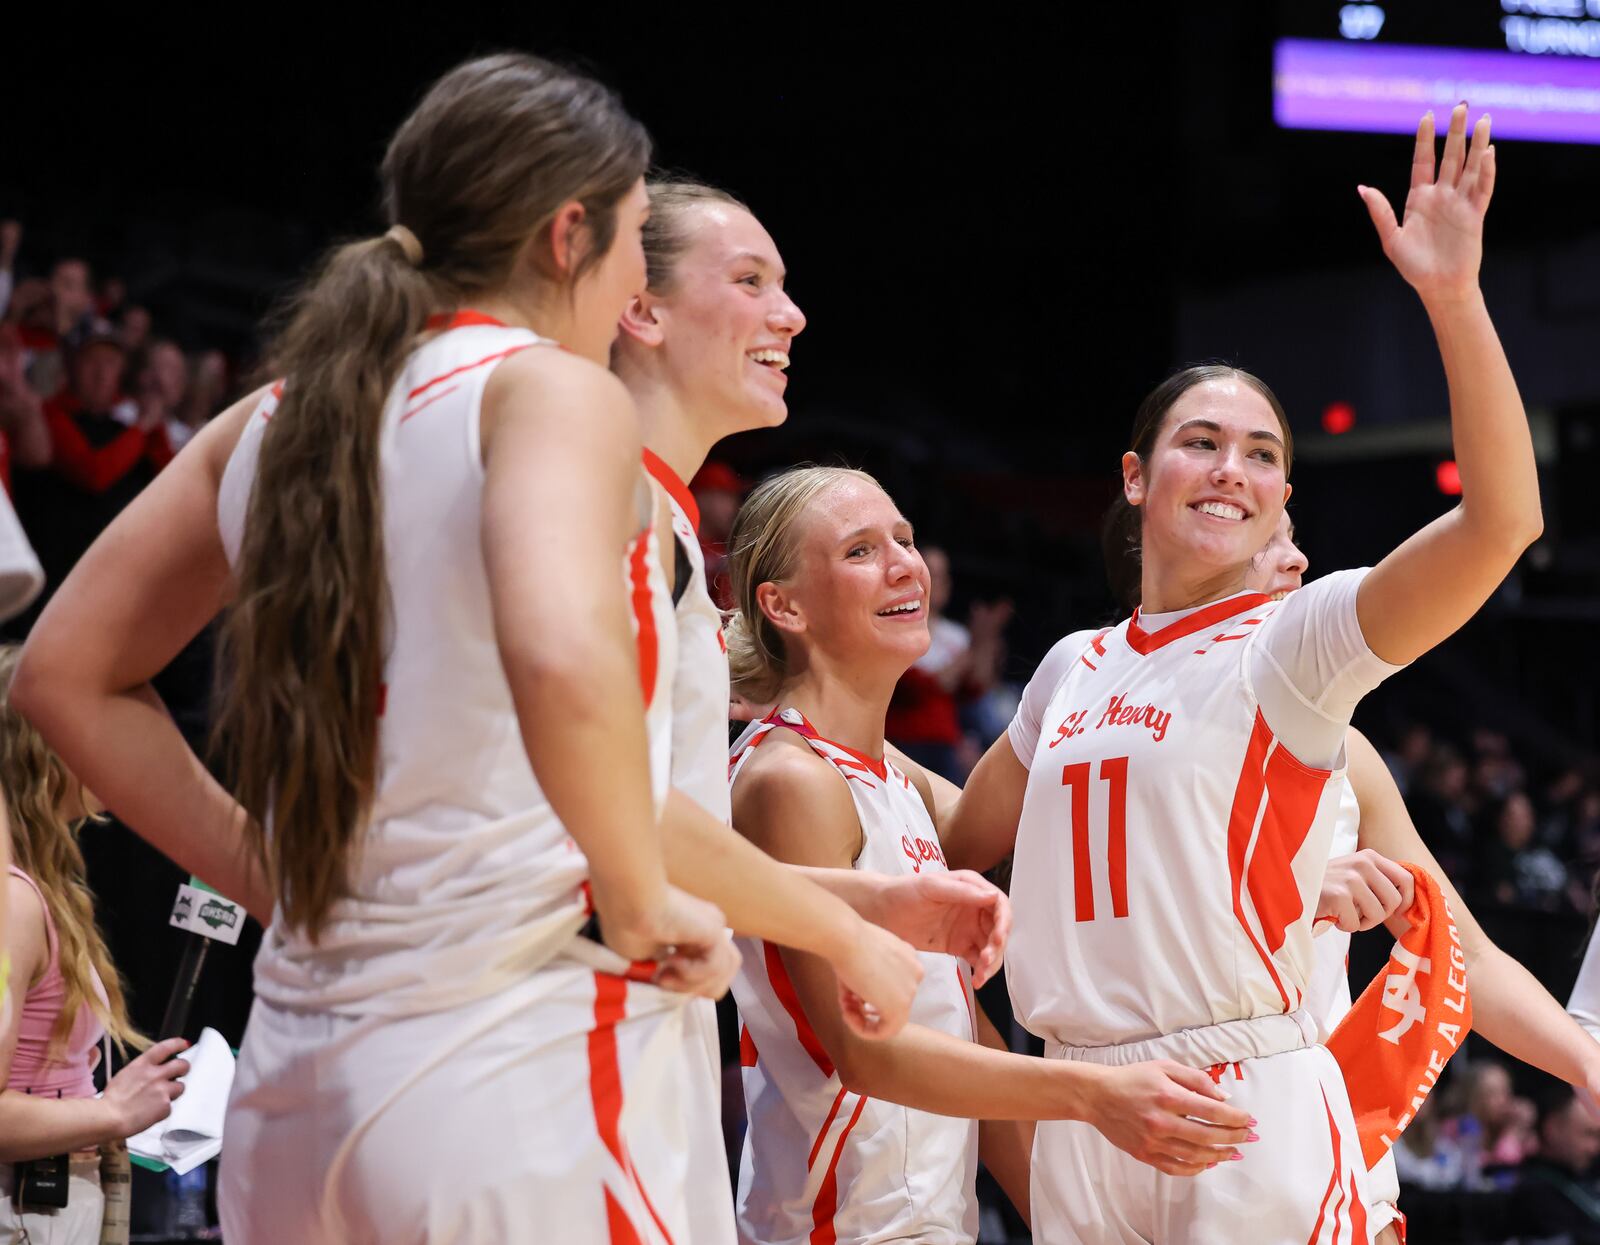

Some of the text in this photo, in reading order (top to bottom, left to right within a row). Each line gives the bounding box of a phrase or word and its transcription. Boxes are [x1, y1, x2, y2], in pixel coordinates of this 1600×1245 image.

[1049, 691, 1172, 748] St. Henry
[1062, 756, 1129, 922] 11
[1437, 1021, 1461, 1048] A
